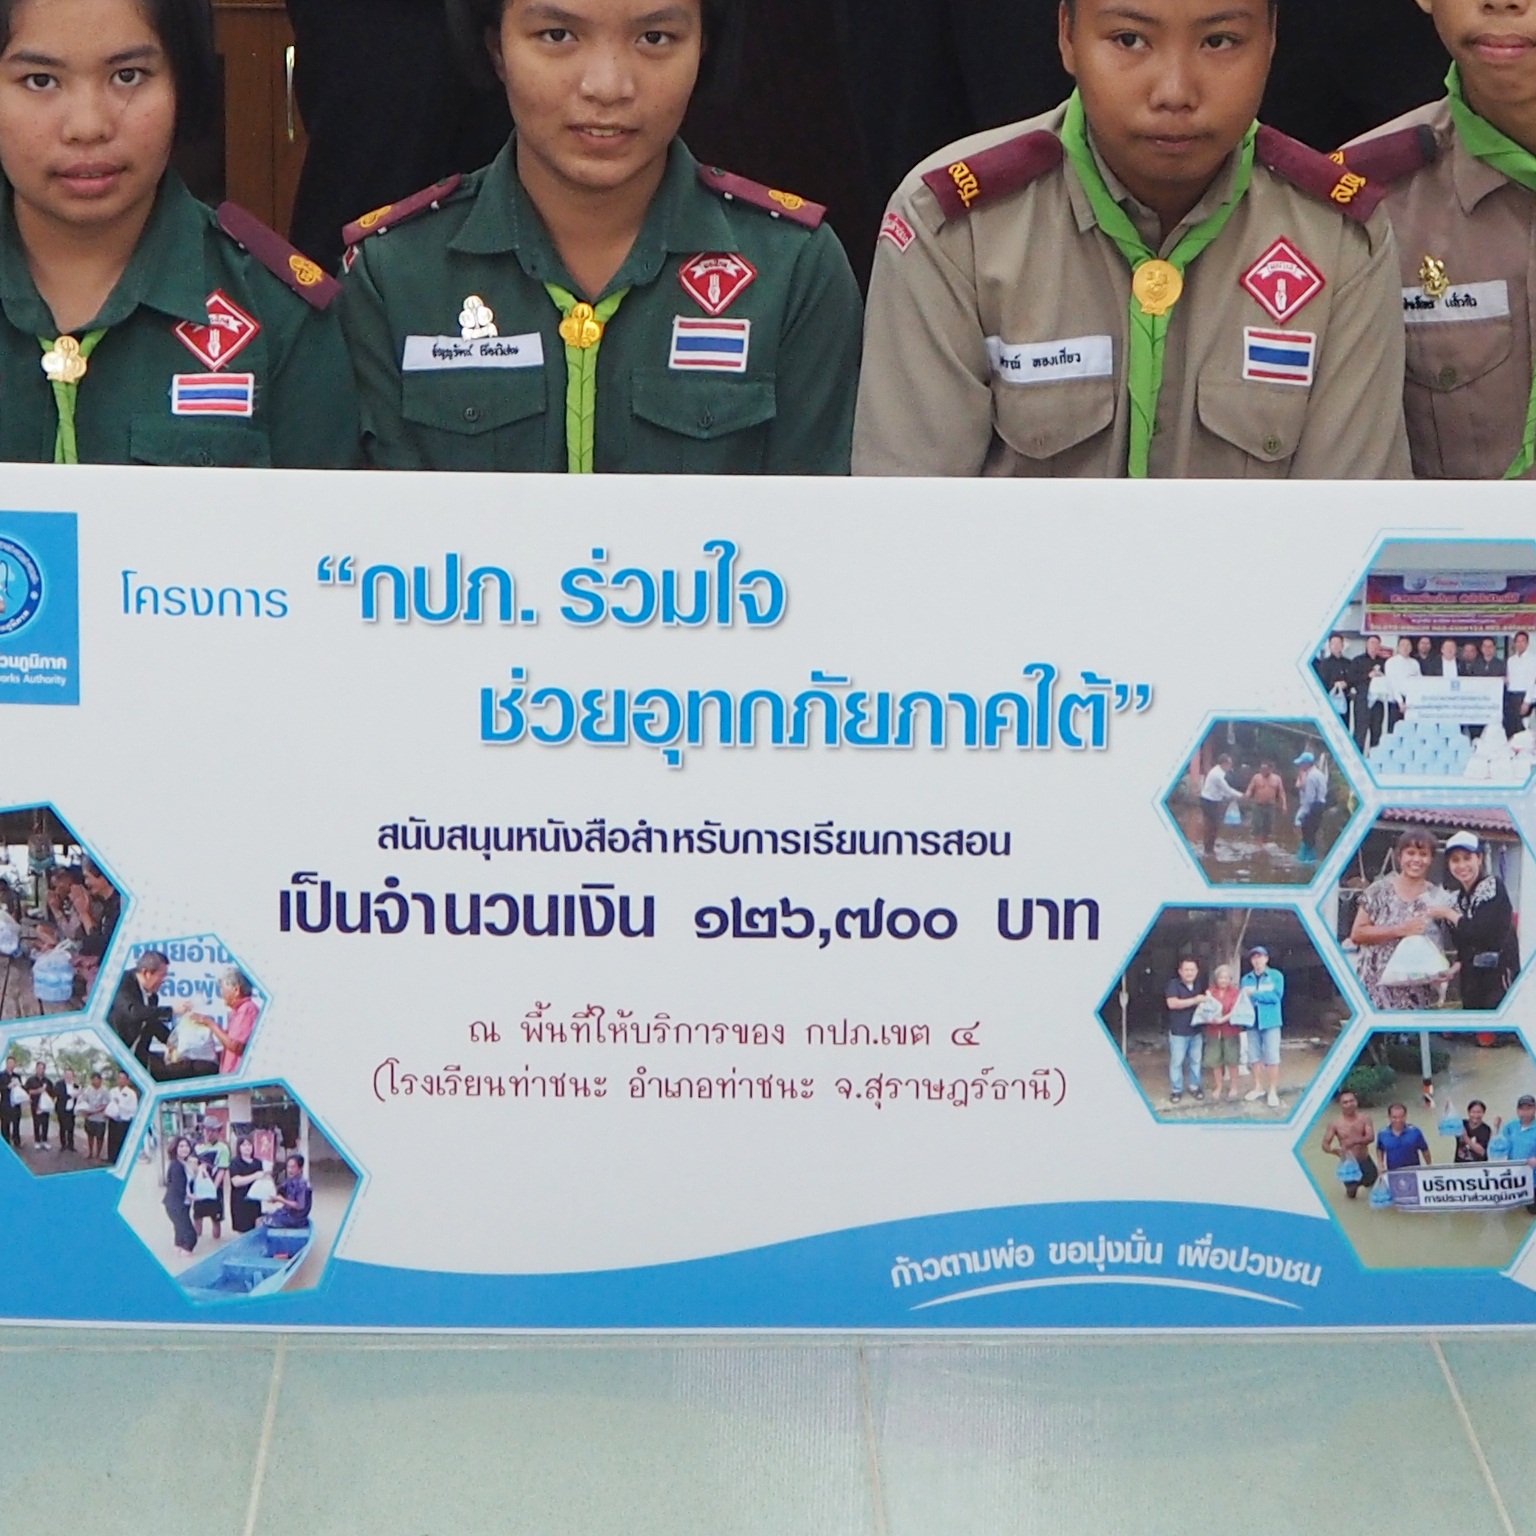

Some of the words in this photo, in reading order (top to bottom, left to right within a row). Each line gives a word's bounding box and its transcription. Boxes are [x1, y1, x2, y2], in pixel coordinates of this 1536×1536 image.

[121, 569, 289, 618] โครงการ
[560, 539, 785, 625] ร่วมใจ
[23, 674, 67, 687] Authority
[376, 816, 1013, 861] สนับสนุนหนังสือสำหรับการเรียนการสอน
[278, 871, 657, 939] เป็นจำนวนเงิน
[693, 895, 959, 950] ๑๒๖,๗๐๐
[997, 897, 1101, 941] บาท
[469, 1019, 501, 1044] ณ
[519, 1001, 785, 1046] พื้นที่ให้บริการของ
[805, 1018, 931, 1046] กปภ.เขต
[628, 1067, 815, 1101] อำเภอท่าชนะ
[1422, 1168, 1527, 1192] บริการน้ำดื่ม
[890, 1237, 1035, 1288] ก้าวตามพ่อ
[1048, 1228, 1164, 1272] ขอมุ่งมั่น
[1178, 1233, 1324, 1288] เพื่อปวงชน
